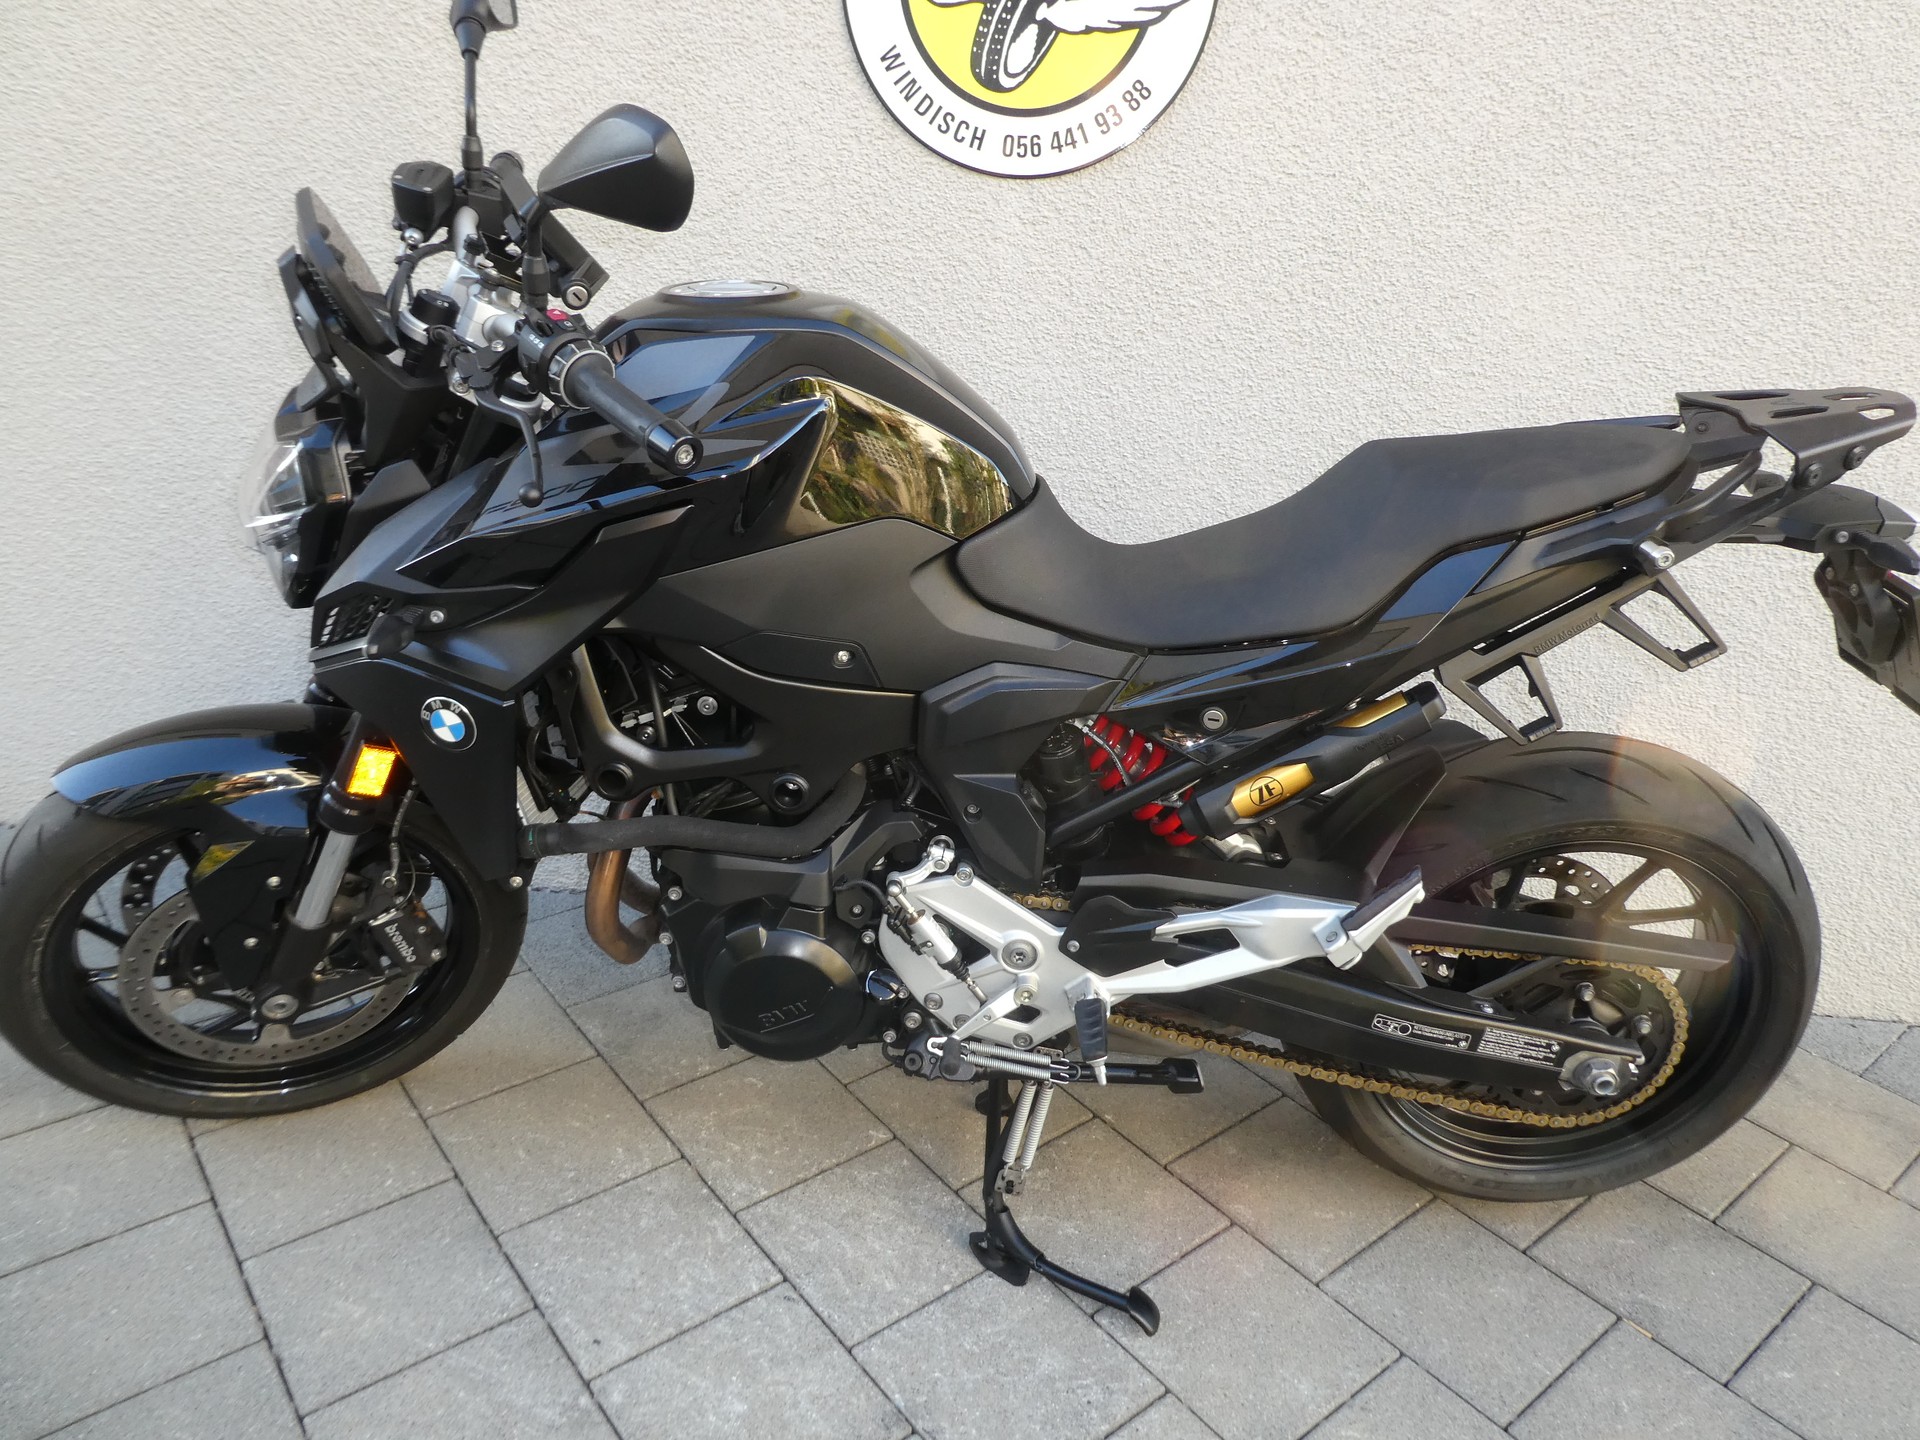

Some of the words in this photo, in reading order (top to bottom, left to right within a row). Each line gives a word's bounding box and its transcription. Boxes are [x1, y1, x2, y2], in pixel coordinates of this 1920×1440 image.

[879, 44, 987, 152] WINDISCH
[1001, 133, 1043, 158] 056
[1049, 123, 1089, 154] 441
[1094, 105, 1123, 135] 93
[1122, 79, 1152, 112] 88
[422, 699, 462, 721] BMW
[1250, 778, 1283, 805] ZF
[384, 922, 417, 963] brembo
